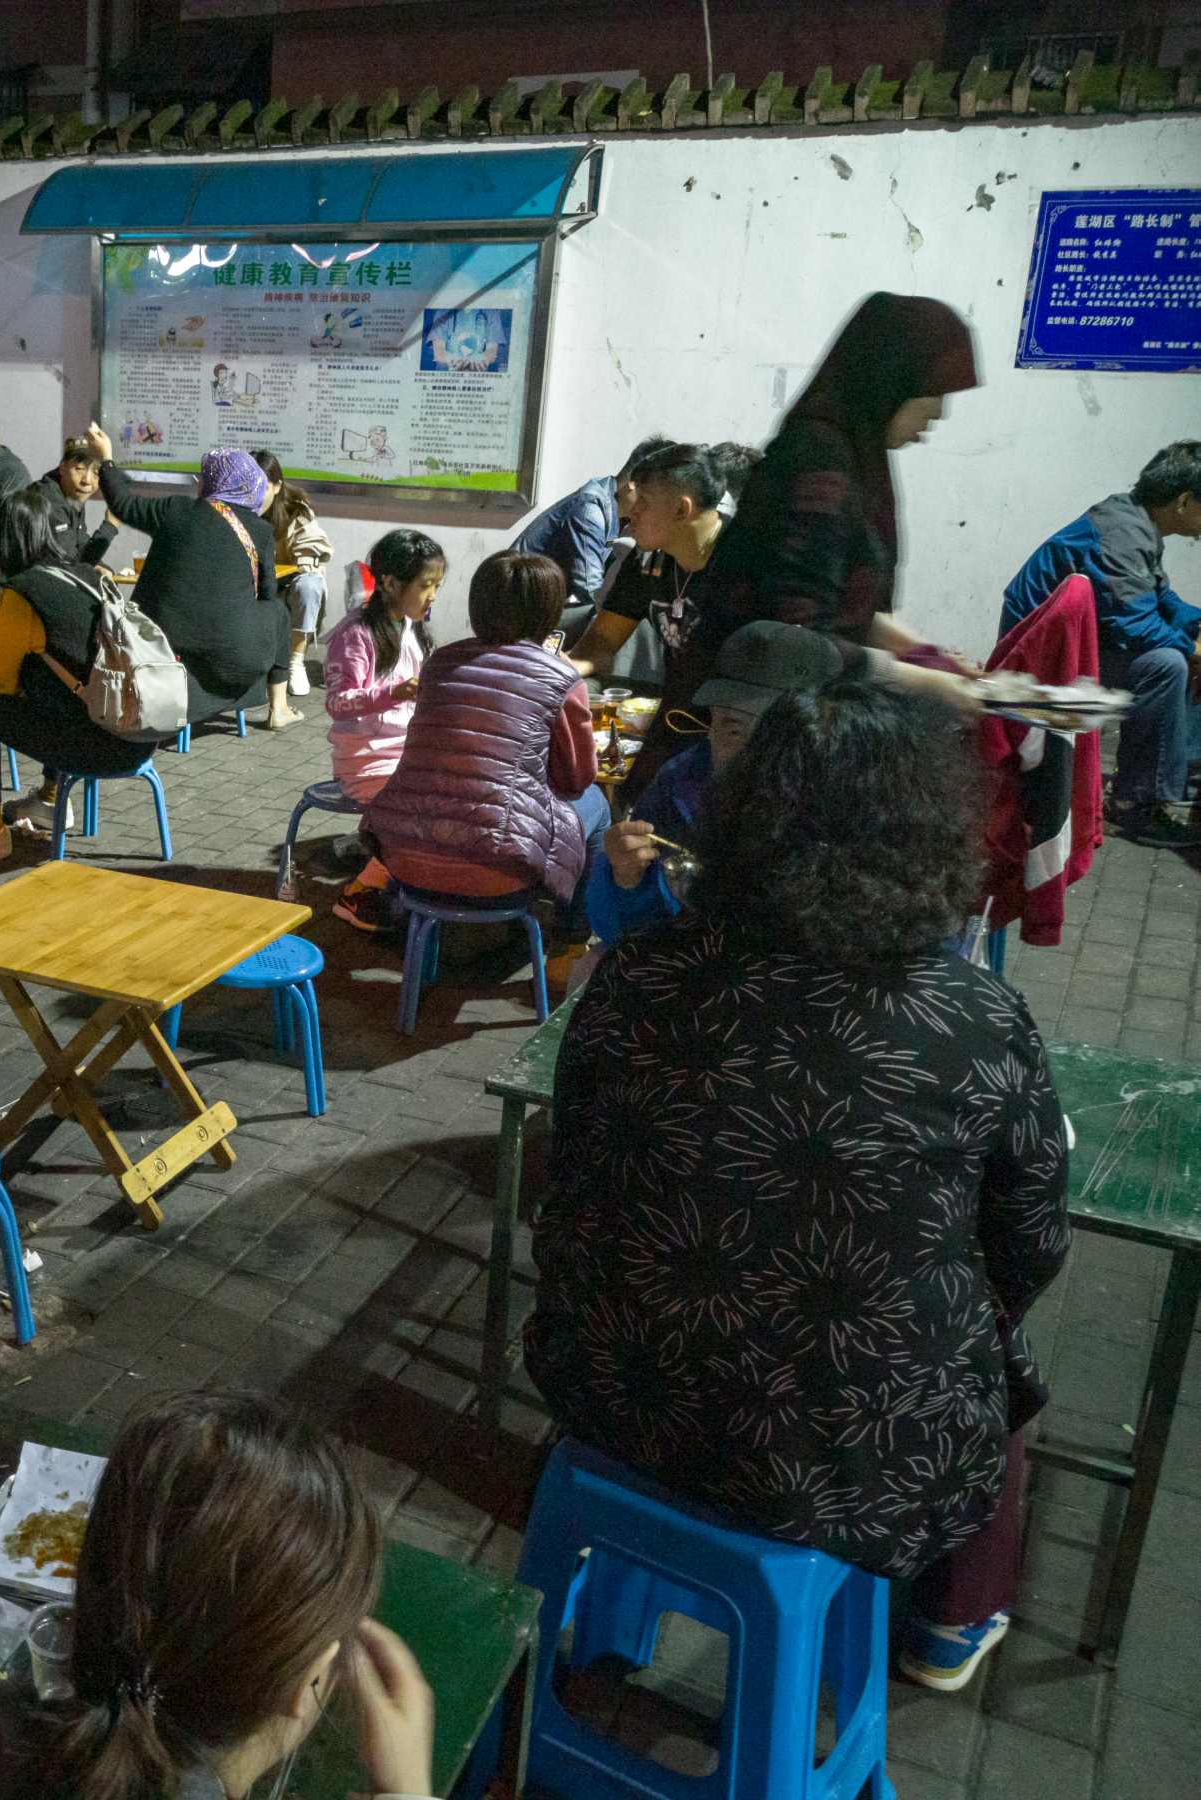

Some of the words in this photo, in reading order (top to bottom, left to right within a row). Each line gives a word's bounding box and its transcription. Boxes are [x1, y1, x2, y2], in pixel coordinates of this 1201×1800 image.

[213, 261, 412, 286] 健康教育宣传栏
